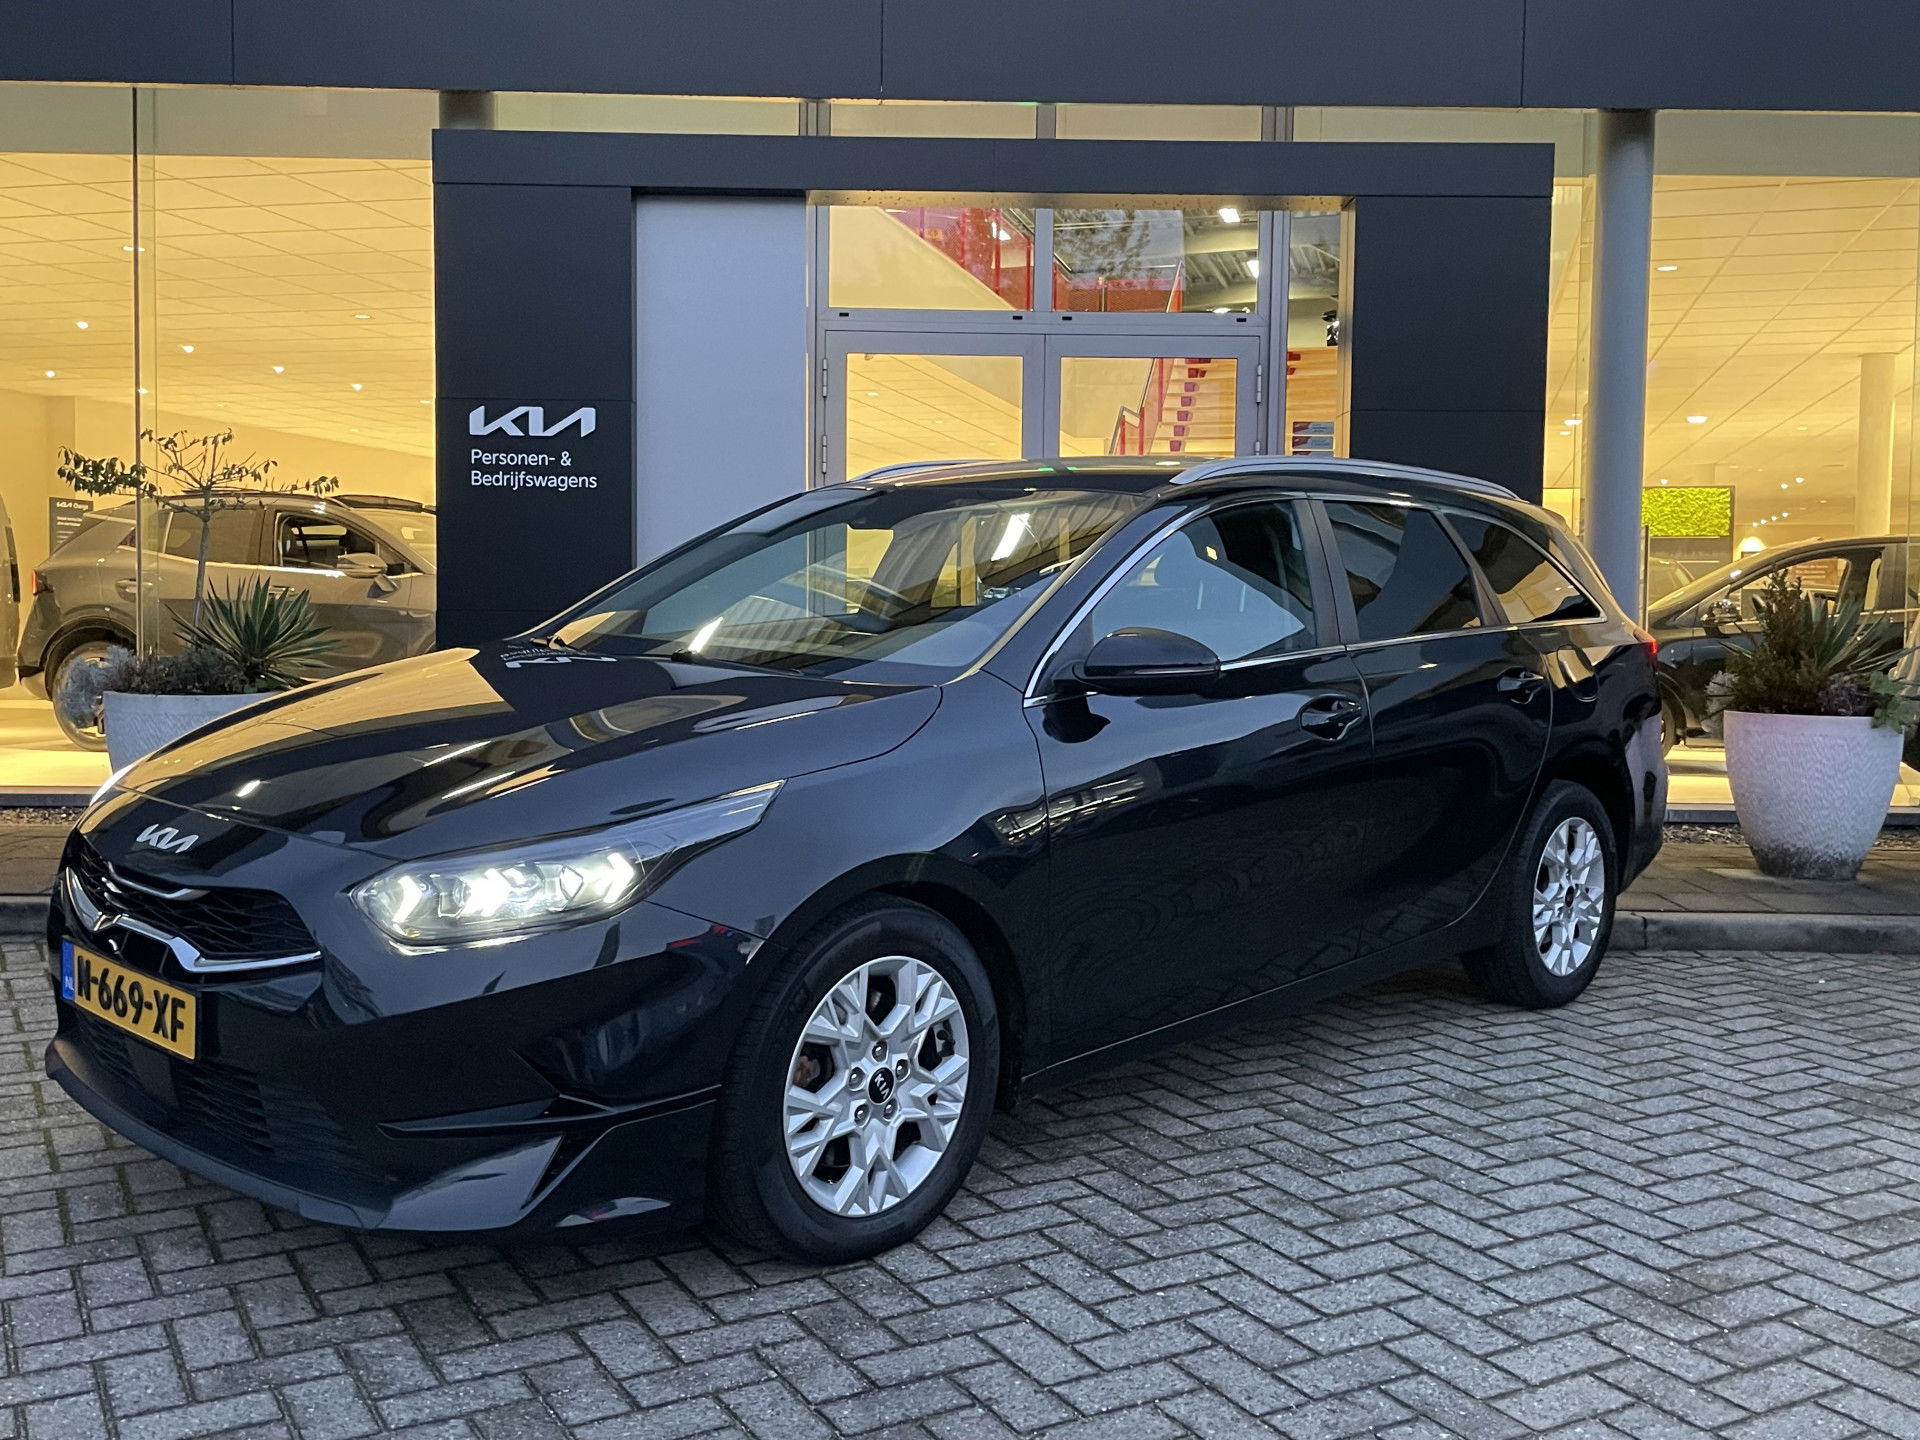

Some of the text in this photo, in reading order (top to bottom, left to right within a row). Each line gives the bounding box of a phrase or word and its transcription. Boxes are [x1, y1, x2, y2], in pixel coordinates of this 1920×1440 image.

[469, 405, 597, 438] KIA
[471, 448, 572, 466] Personen- &
[471, 470, 598, 492] Bedrijfswagens
[135, 823, 199, 854] KIA
[77, 955, 186, 1043] N-669-XF
[874, 1073, 891, 1100] KIA
